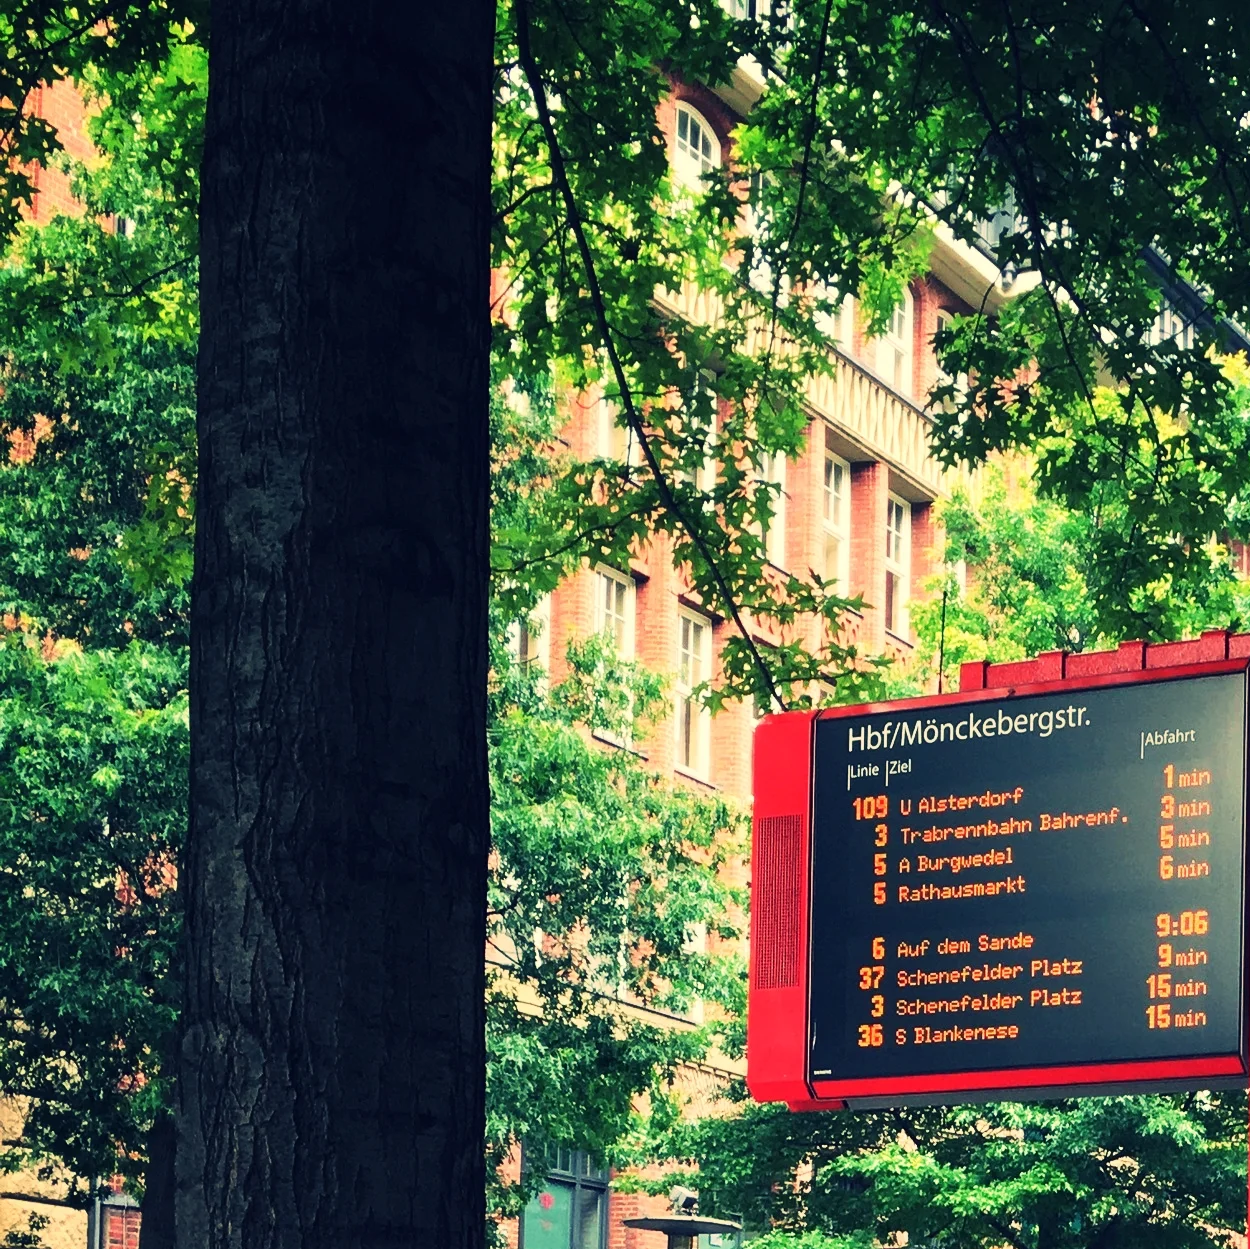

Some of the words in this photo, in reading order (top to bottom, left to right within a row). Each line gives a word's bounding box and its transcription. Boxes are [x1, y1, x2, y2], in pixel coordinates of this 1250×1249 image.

[848, 705, 1091, 752] Hbf/Mönckebergstr.
[1145, 729, 1196, 746] Abfahrt
[850, 763, 880, 779] Linie
[889, 759, 912, 775] Ziel
[1163, 764, 1174, 788] 1
[1178, 769, 1211, 787] min
[852, 795, 888, 820] 109
[900, 799, 912, 816] U
[918, 787, 1024, 813] Alsterdorf
[1160, 795, 1175, 819] 3
[1178, 799, 1211, 818] min
[875, 824, 888, 847] 3
[901, 820, 1032, 845] Trabrennbahn
[1039, 807, 1128, 831] Bahrenf.
[1160, 825, 1174, 849] 5
[1178, 829, 1210, 848] min
[874, 853, 887, 876] 5
[899, 857, 910, 873] A
[917, 847, 1013, 873] Burgwedel
[1160, 855, 1174, 879] 6
[1177, 860, 1209, 878] min
[874, 882, 887, 905] 5
[898, 875, 1026, 902] Rathausmarkt
[1156, 910, 1209, 937] 9:06
[872, 936, 886, 960] 6
[897, 940, 930, 958] Auf
[937, 938, 971, 955] dem
[978, 932, 1035, 952] Sande
[1158, 943, 1172, 968] 9
[1175, 948, 1207, 966] min
[859, 966, 885, 990] 37
[897, 963, 1024, 987] Schenefelder
[1030, 958, 1083, 977] Platz
[1146, 974, 1172, 999] 15
[1175, 979, 1207, 997] min
[871, 995, 885, 1018] 3
[896, 993, 1024, 1016] Schenefelder
[1030, 988, 1082, 1008] Platz
[1145, 1004, 1171, 1029] 15
[1175, 1009, 1207, 1027] min
[858, 1024, 884, 1048] 36
[895, 1029, 906, 1045] S
[914, 1025, 1019, 1044] Blankenese
